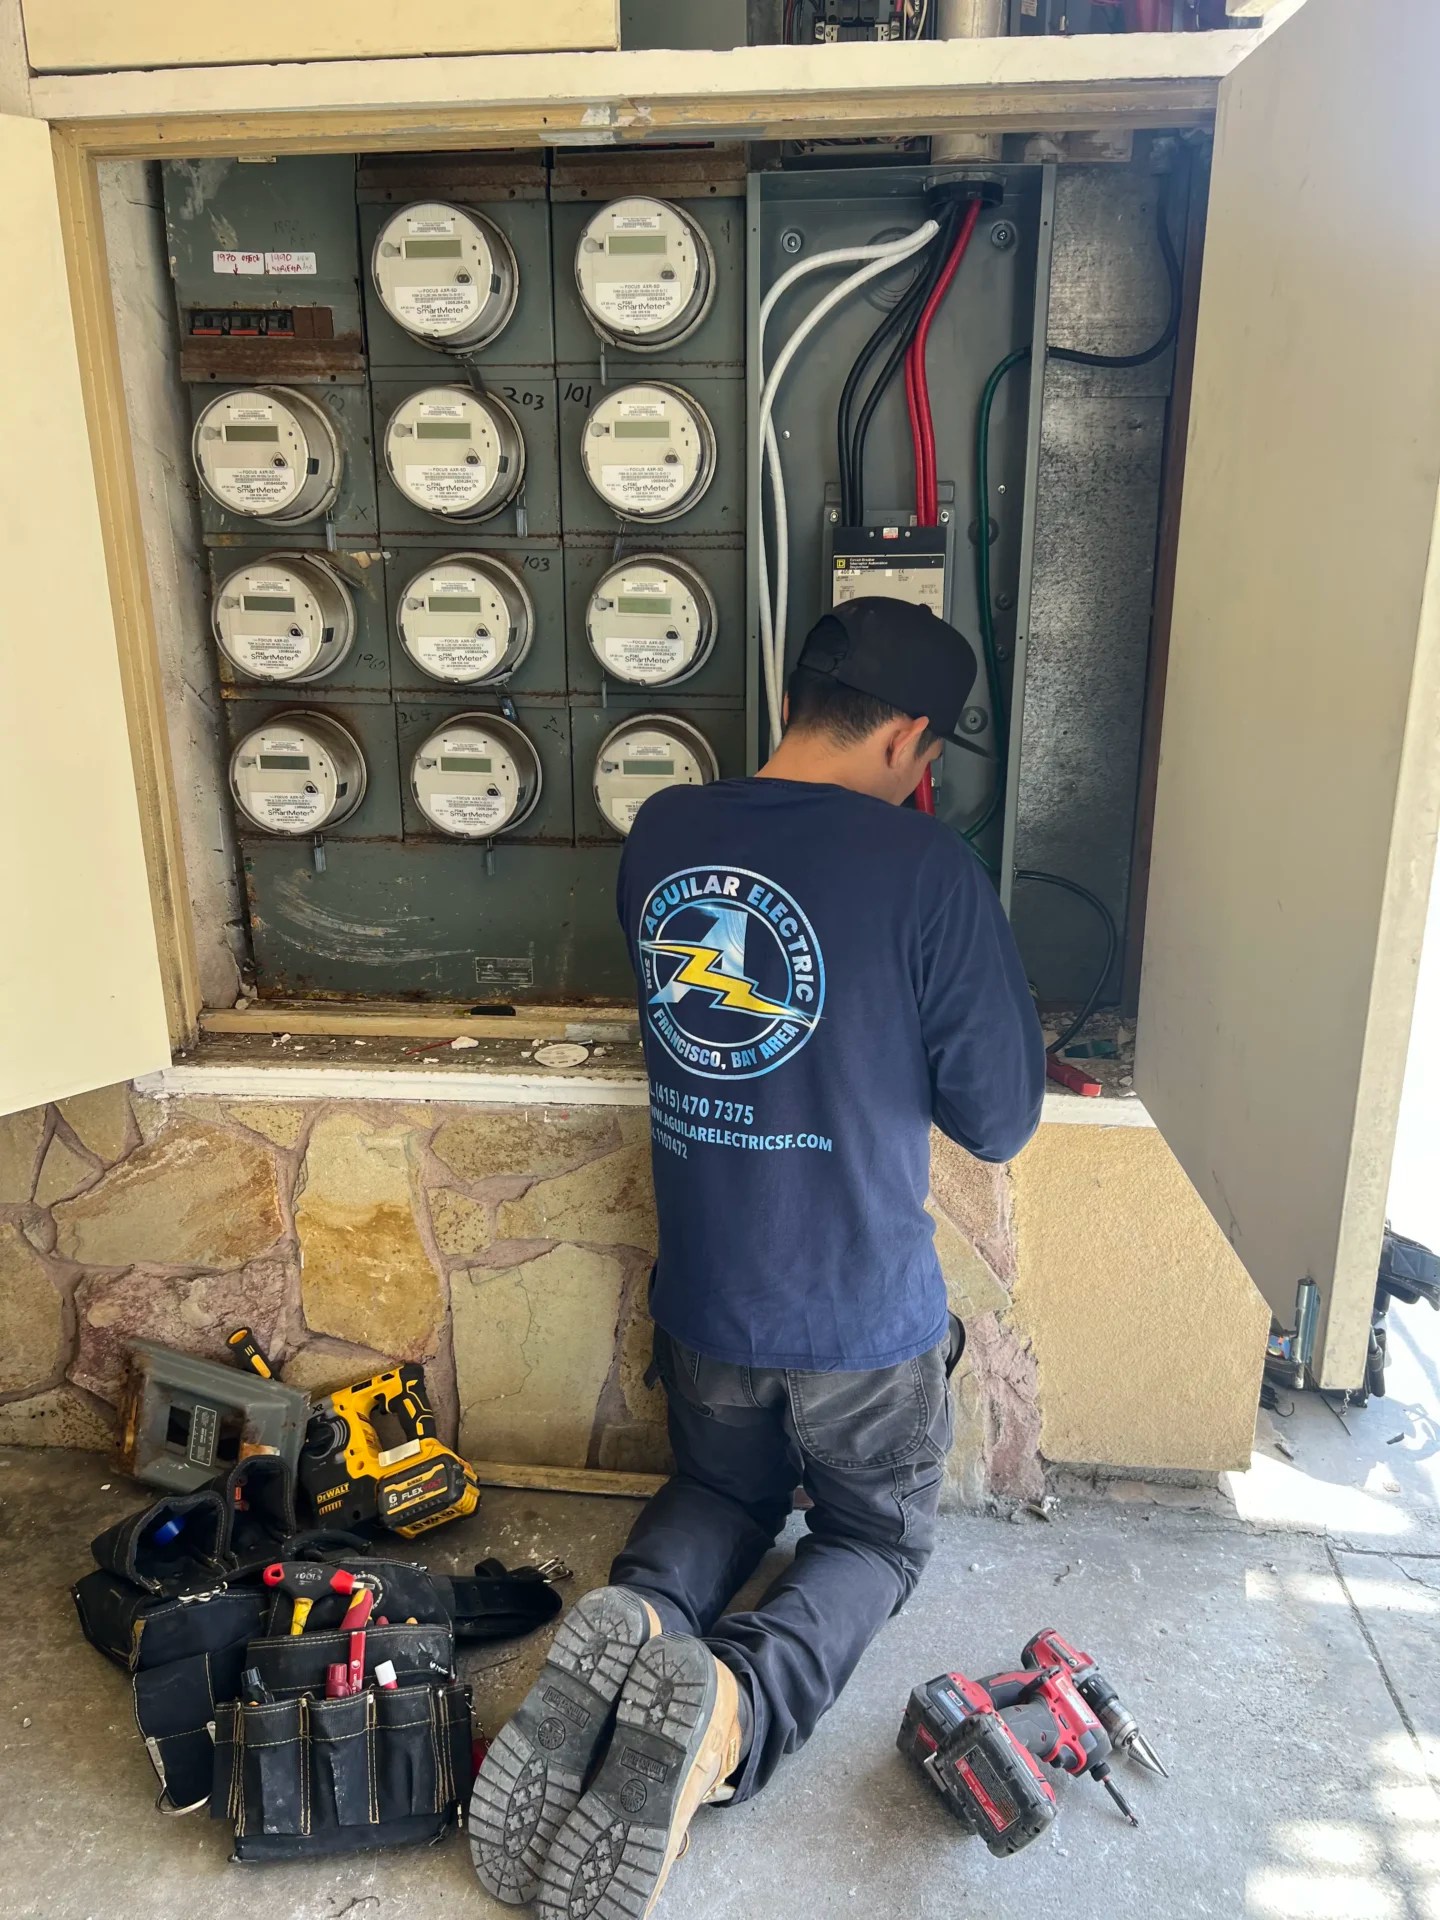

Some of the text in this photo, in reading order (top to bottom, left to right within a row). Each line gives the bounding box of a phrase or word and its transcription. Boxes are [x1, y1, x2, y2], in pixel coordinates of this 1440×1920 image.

[217, 253, 236, 262] 1970
[416, 306, 464, 314] SmartMeter
[617, 303, 666, 311] SmartMeter
[503, 387, 544, 410] 203
[564, 383, 591, 408] 101
[236, 486, 282, 494] SmartMeter
[426, 484, 472, 492] SmartMeter
[622, 484, 670, 492] SmartMeter
[522, 556, 550, 572] 103
[250, 653, 295, 661] SmartMeter
[438, 654, 483, 662] SmartMeter
[624, 656, 670, 664] SmartMeter
[449, 810, 493, 818] SmartMeter
[645, 875, 814, 1003] AGUILAR ELECTRIC
[653, 1009, 726, 1070] FRANCISCO,
[732, 1055, 758, 1069] BAY
[760, 1022, 799, 1059] AREA
[656, 1081, 680, 1113] (415)
[682, 1094, 710, 1118] 470
[714, 1099, 754, 1125] 7375
[388, 1493, 397, 1504] 6
